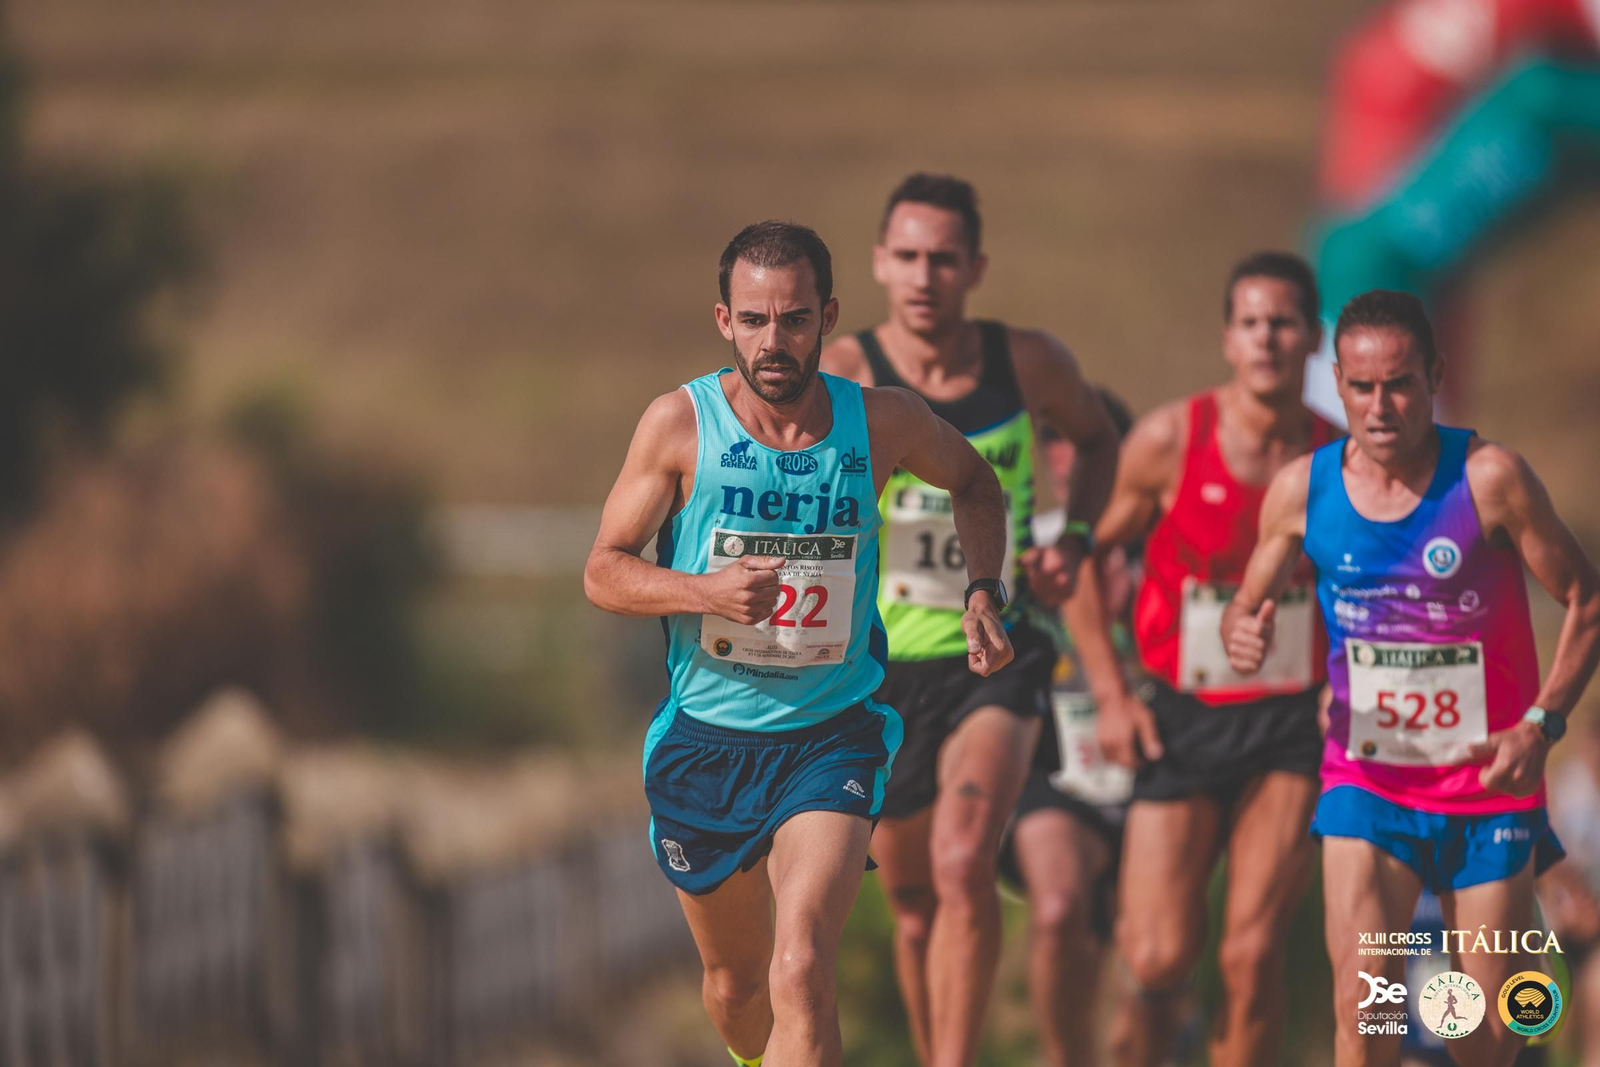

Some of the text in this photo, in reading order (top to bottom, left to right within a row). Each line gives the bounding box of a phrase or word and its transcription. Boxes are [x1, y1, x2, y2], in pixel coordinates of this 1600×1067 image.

[720, 453, 757, 464] CUEVA
[777, 454, 816, 471] TROPS
[720, 482, 859, 535] nerja
[754, 538, 821, 555] ITÁLICA
[769, 584, 829, 627] 22
[1376, 690, 1461, 730] 528
